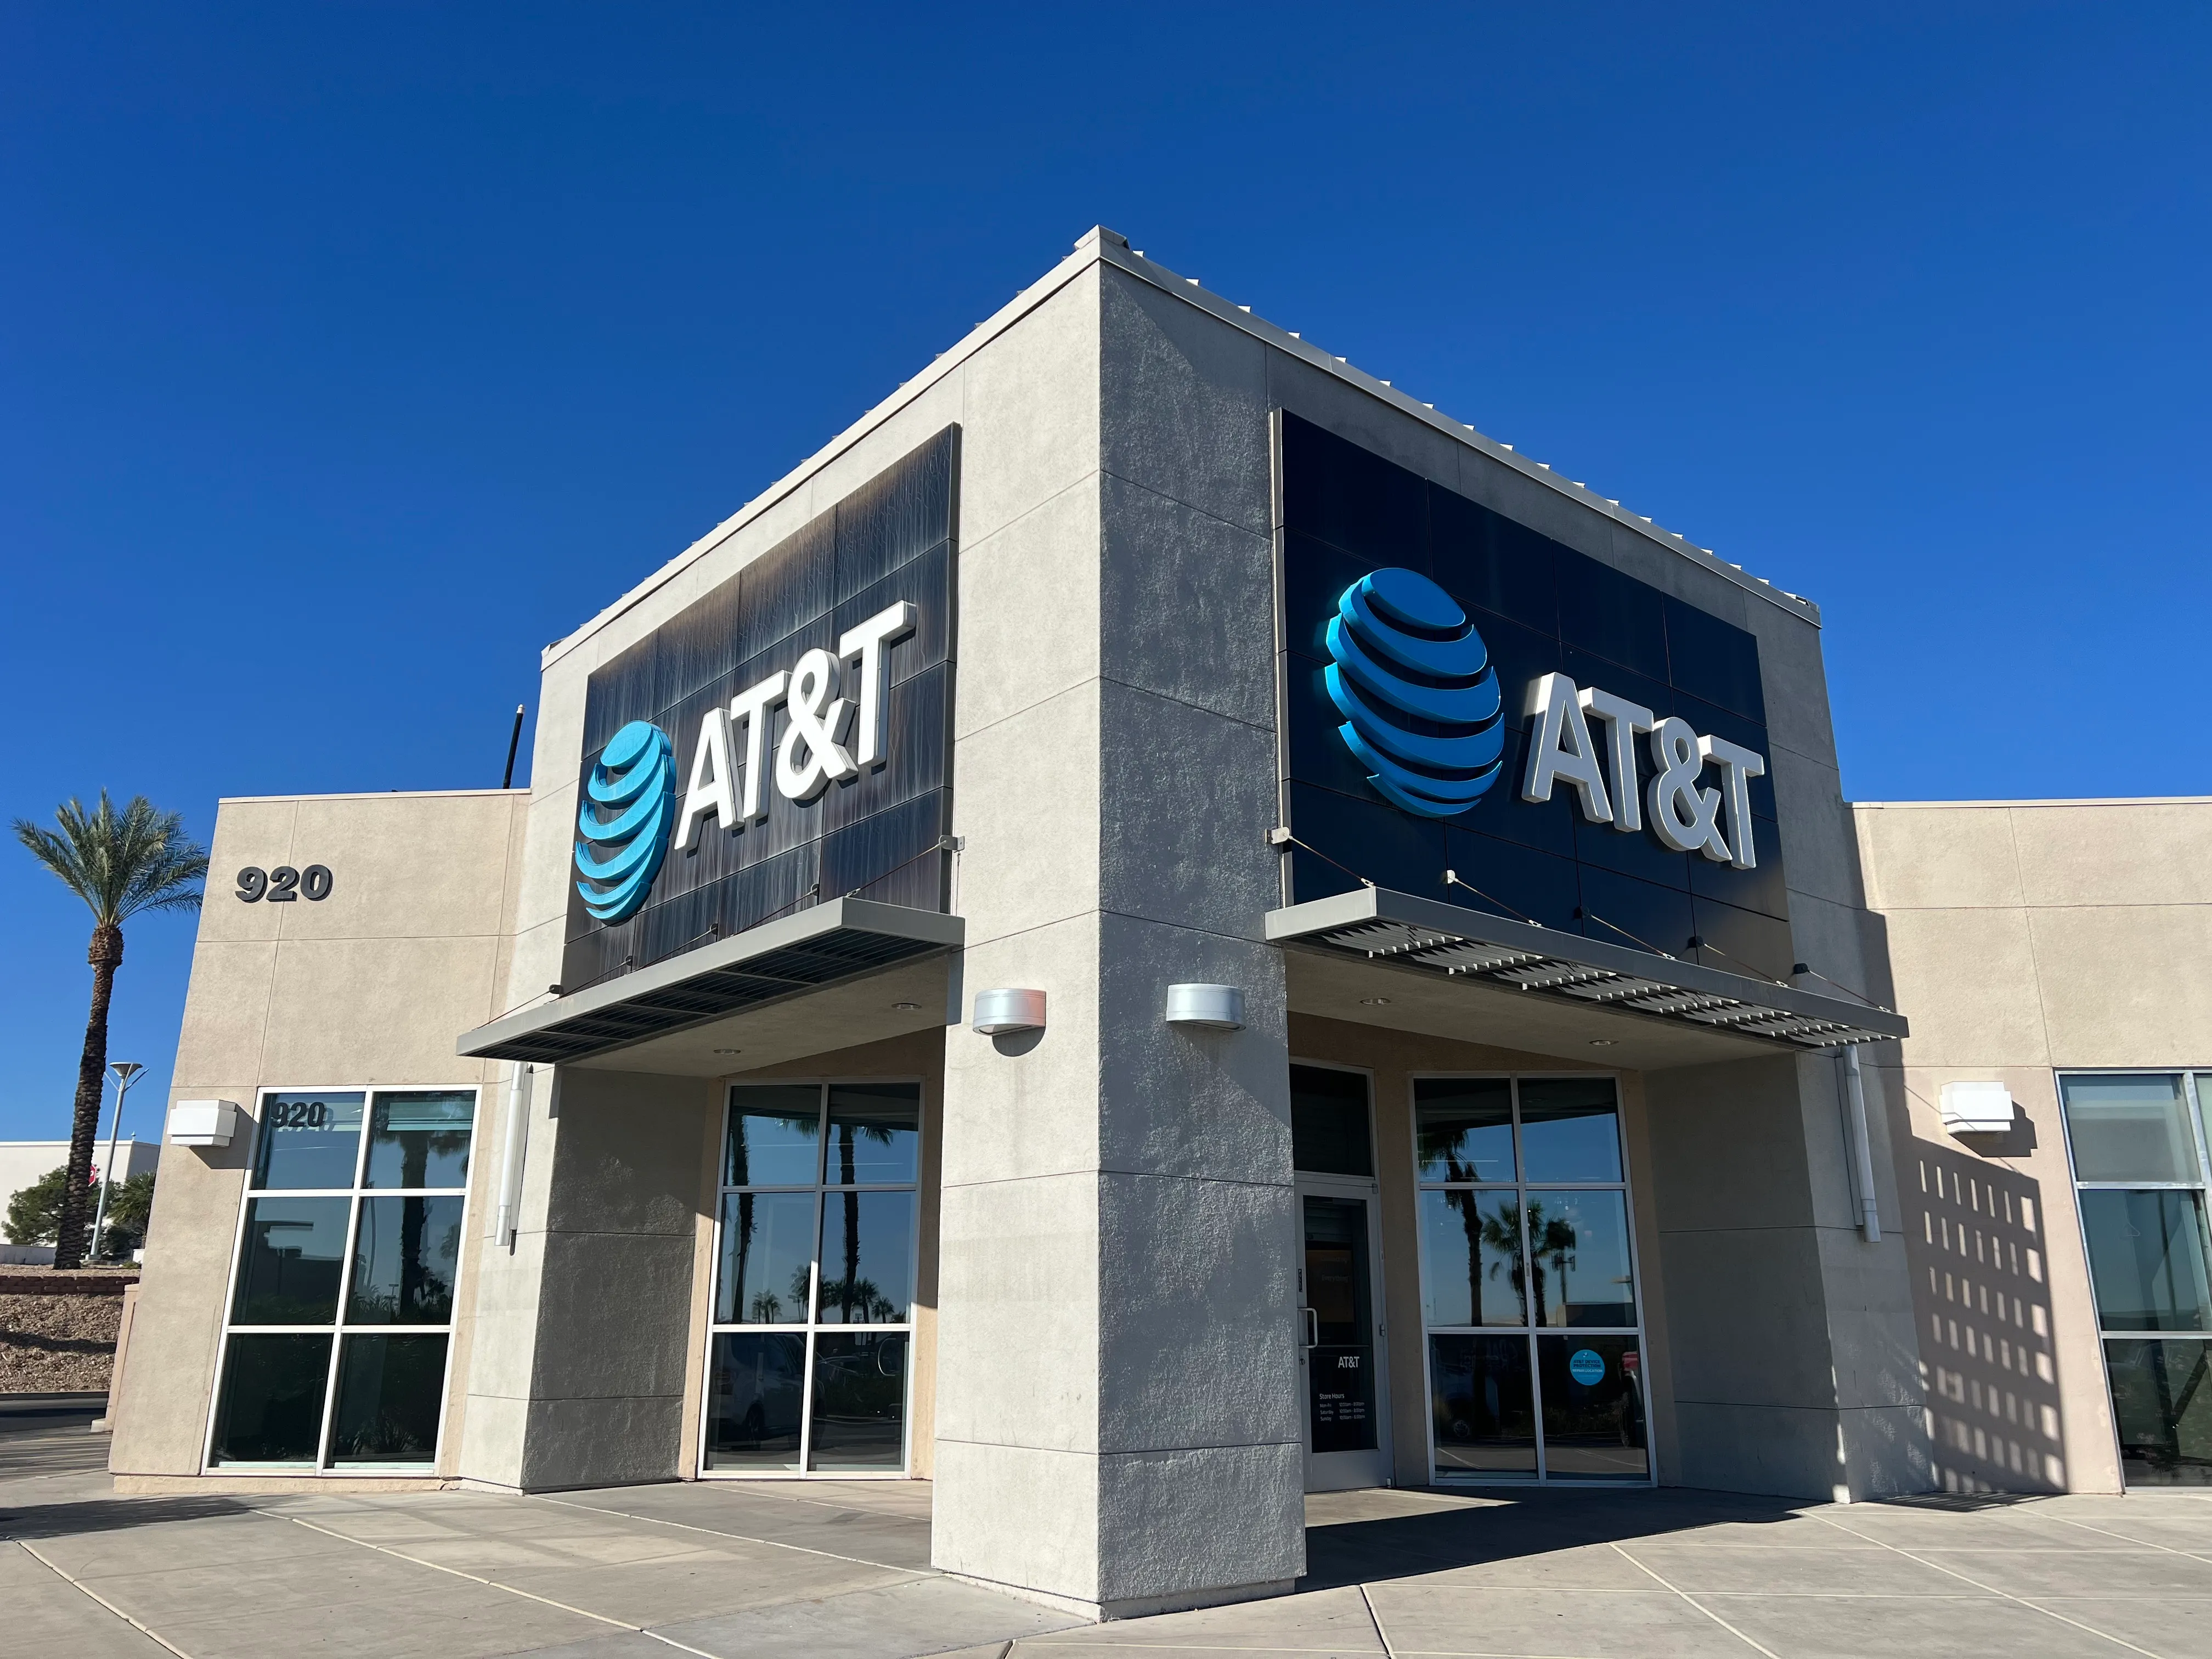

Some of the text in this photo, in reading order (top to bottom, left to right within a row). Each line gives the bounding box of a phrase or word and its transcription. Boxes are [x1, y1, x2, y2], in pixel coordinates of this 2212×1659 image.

[674, 600, 917, 851] AT&T
[1521, 672, 1764, 870] AT&T
[235, 864, 333, 903] 920
[270, 1102, 325, 1127] 920
[1338, 1356, 1360, 1368] AT&T
